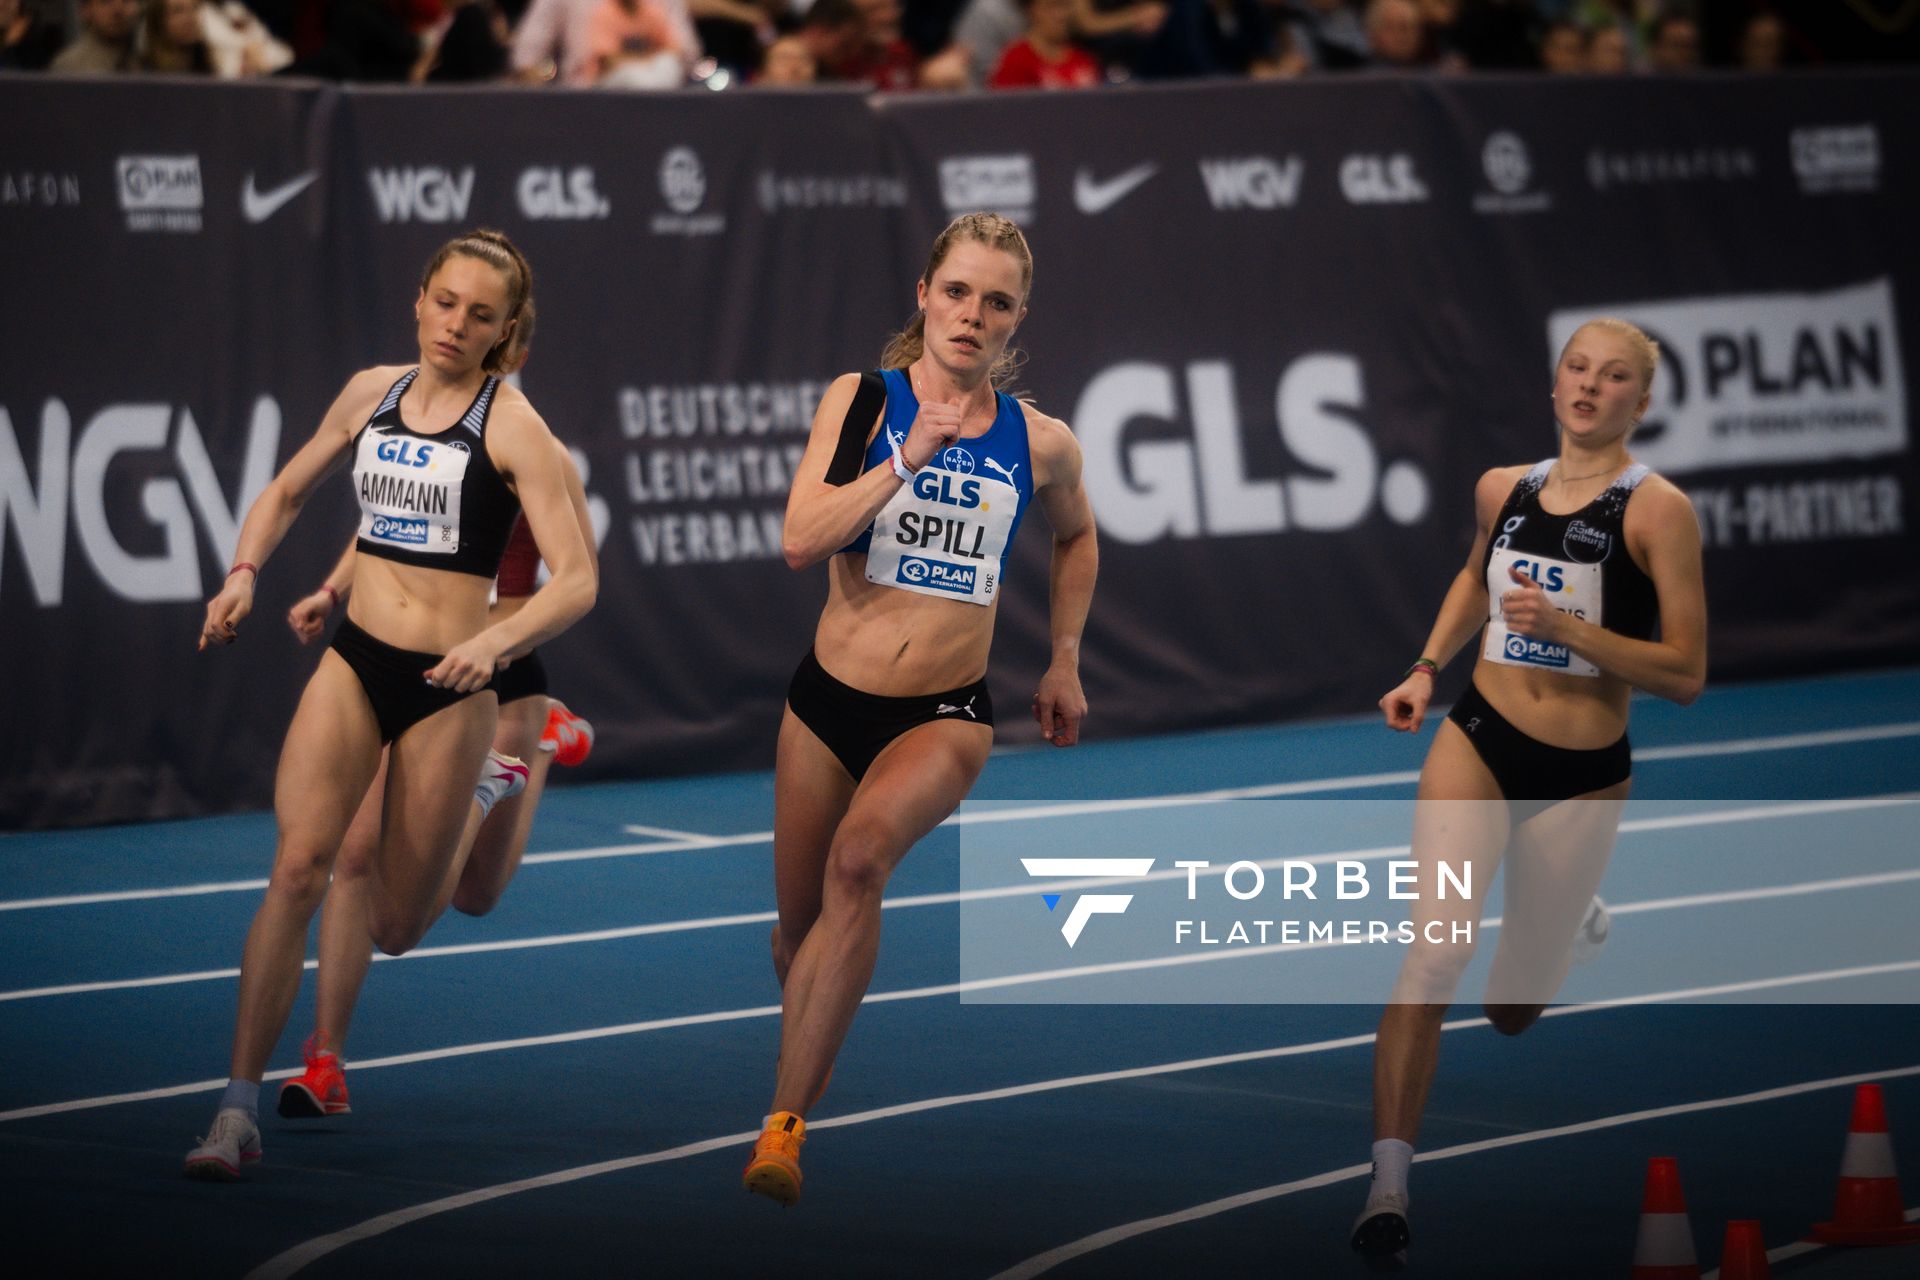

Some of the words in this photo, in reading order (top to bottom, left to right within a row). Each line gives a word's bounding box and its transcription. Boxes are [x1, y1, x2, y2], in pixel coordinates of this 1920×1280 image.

[369, 165, 475, 223] WGV
[1199, 155, 1303, 210] WGV
[1703, 322, 1885, 398] PLAN
[618, 380, 830, 440] DEUTSCHE
[1073, 350, 1431, 546] GLS.
[361, 471, 448, 515] AMMANN
[389, 520, 426, 535] PLAN
[441, 525, 452, 542] 368
[895, 511, 985, 560] SPILL
[930, 579, 972, 591] INTERNATIONAL
[931, 565, 974, 584] PLAN
[984, 573, 994, 594] 303
[1528, 642, 1567, 658] PLAN
